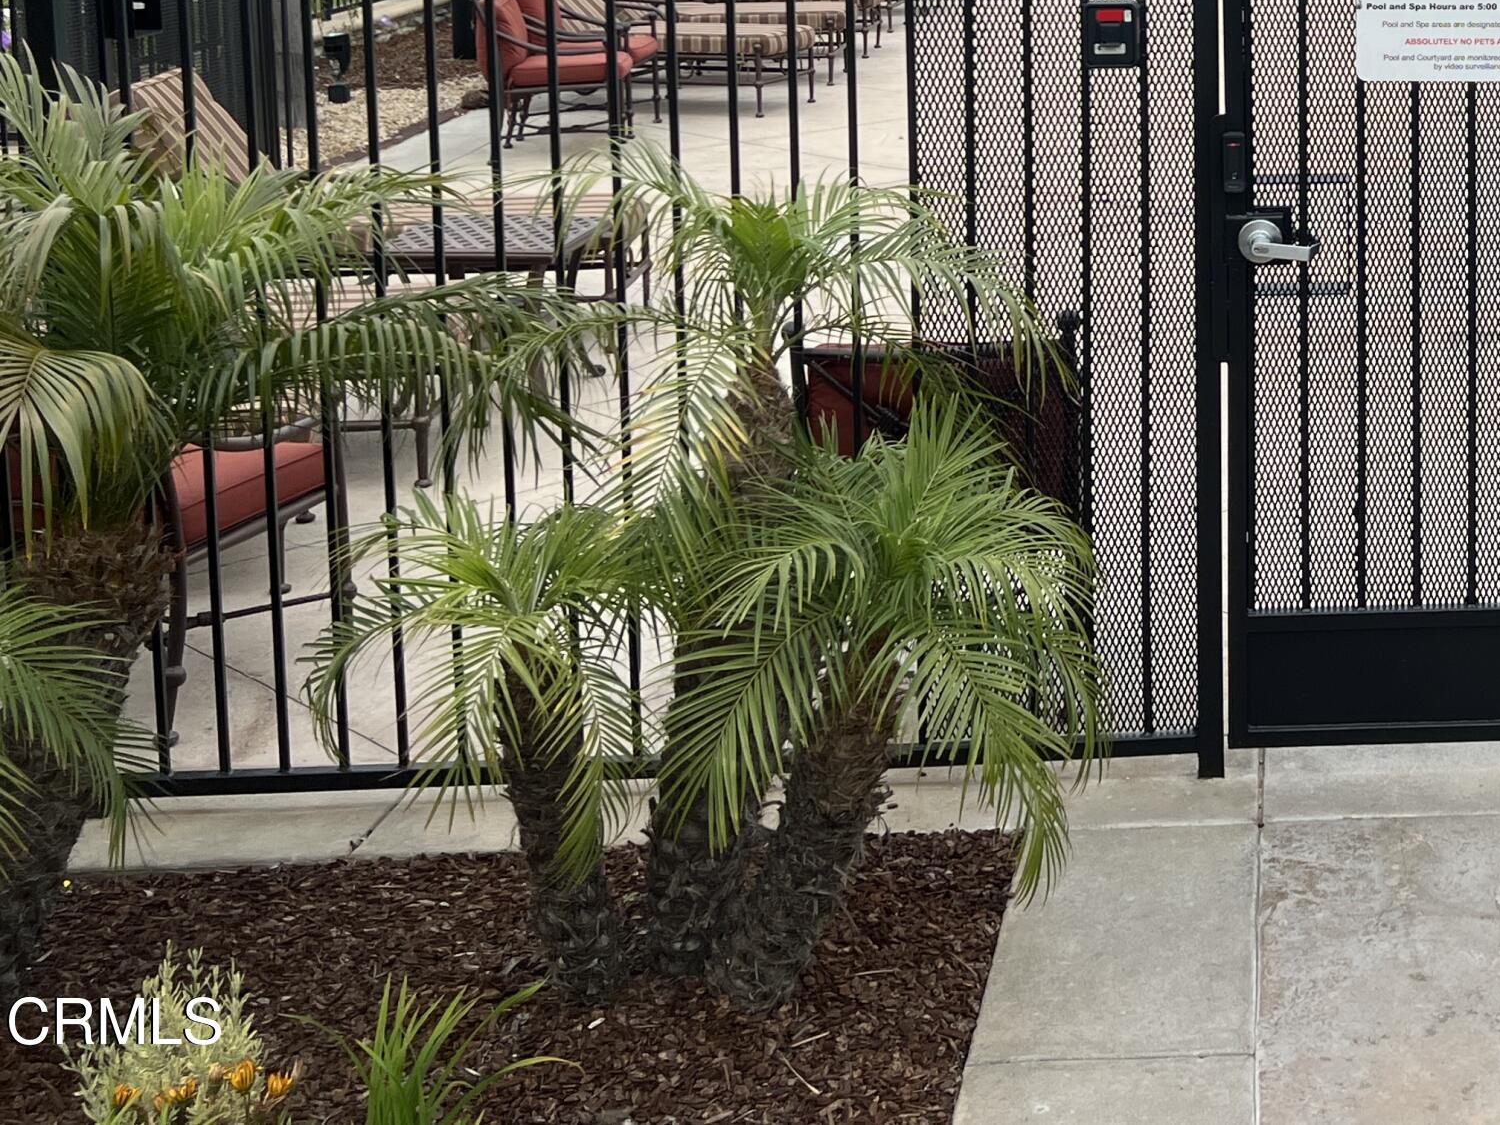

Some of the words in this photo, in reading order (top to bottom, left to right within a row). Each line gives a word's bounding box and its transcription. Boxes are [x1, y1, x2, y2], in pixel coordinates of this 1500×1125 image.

[1366, 2, 1387, 11] Pool
[1389, 2, 1407, 11] and
[1408, 2, 1427, 13] Spa
[1429, 2, 1457, 11] Hours
[1477, 2, 1498, 11] 5:00
[1382, 20, 1399, 28] Pool
[1400, 20, 1414, 28] and
[1415, 20, 1430, 29] Spa
[1383, 54, 1400, 62] Pool
[1401, 54, 1416, 62] and
[1416, 54, 1452, 63] Courtyard
[1433, 63, 1443, 71] by
